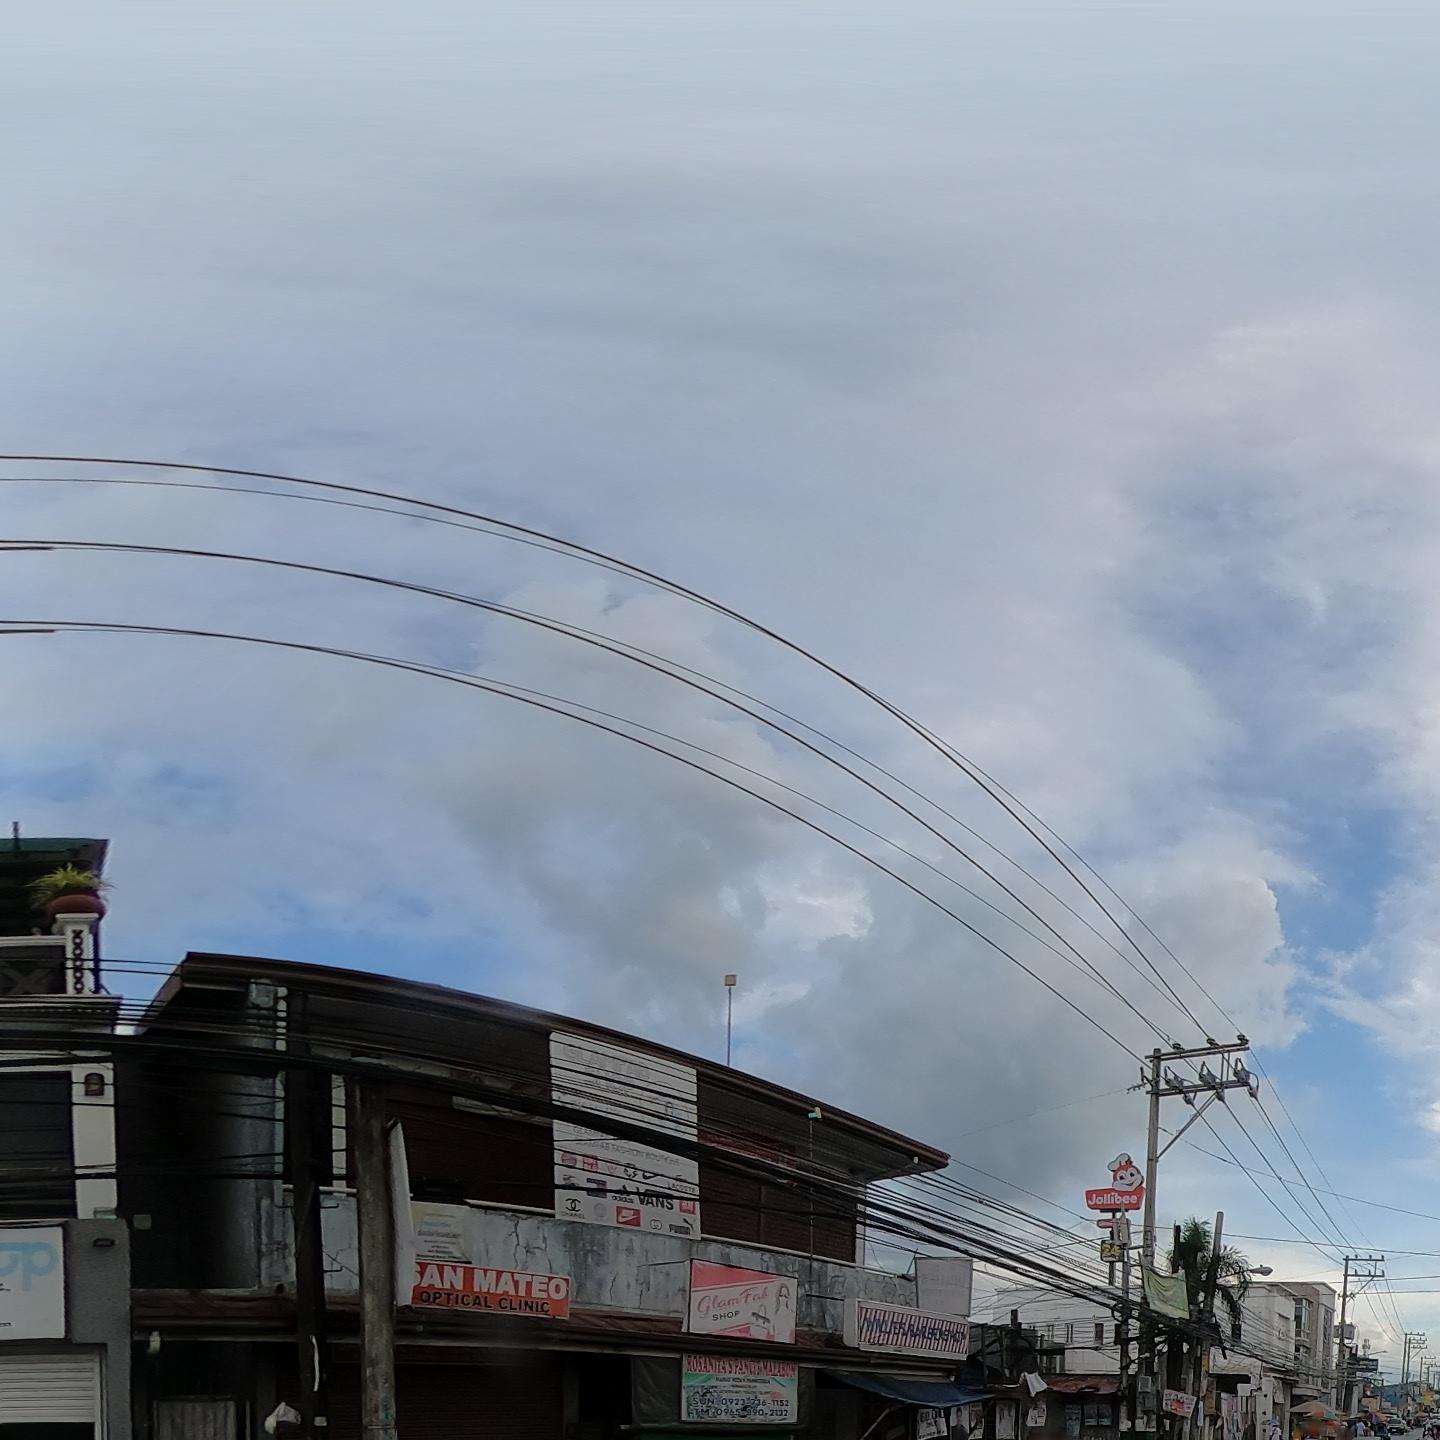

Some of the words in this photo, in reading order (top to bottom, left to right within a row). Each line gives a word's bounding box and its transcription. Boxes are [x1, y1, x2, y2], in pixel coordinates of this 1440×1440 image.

[637, 1187, 674, 1211] VANS
[1088, 1192, 1138, 1205] Jollibee
[473, 1269, 568, 1300] MATEO
[420, 1290, 492, 1309] OPTICAL
[498, 1297, 550, 1313] CLINIC
[712, 1310, 740, 1321] SHOP
